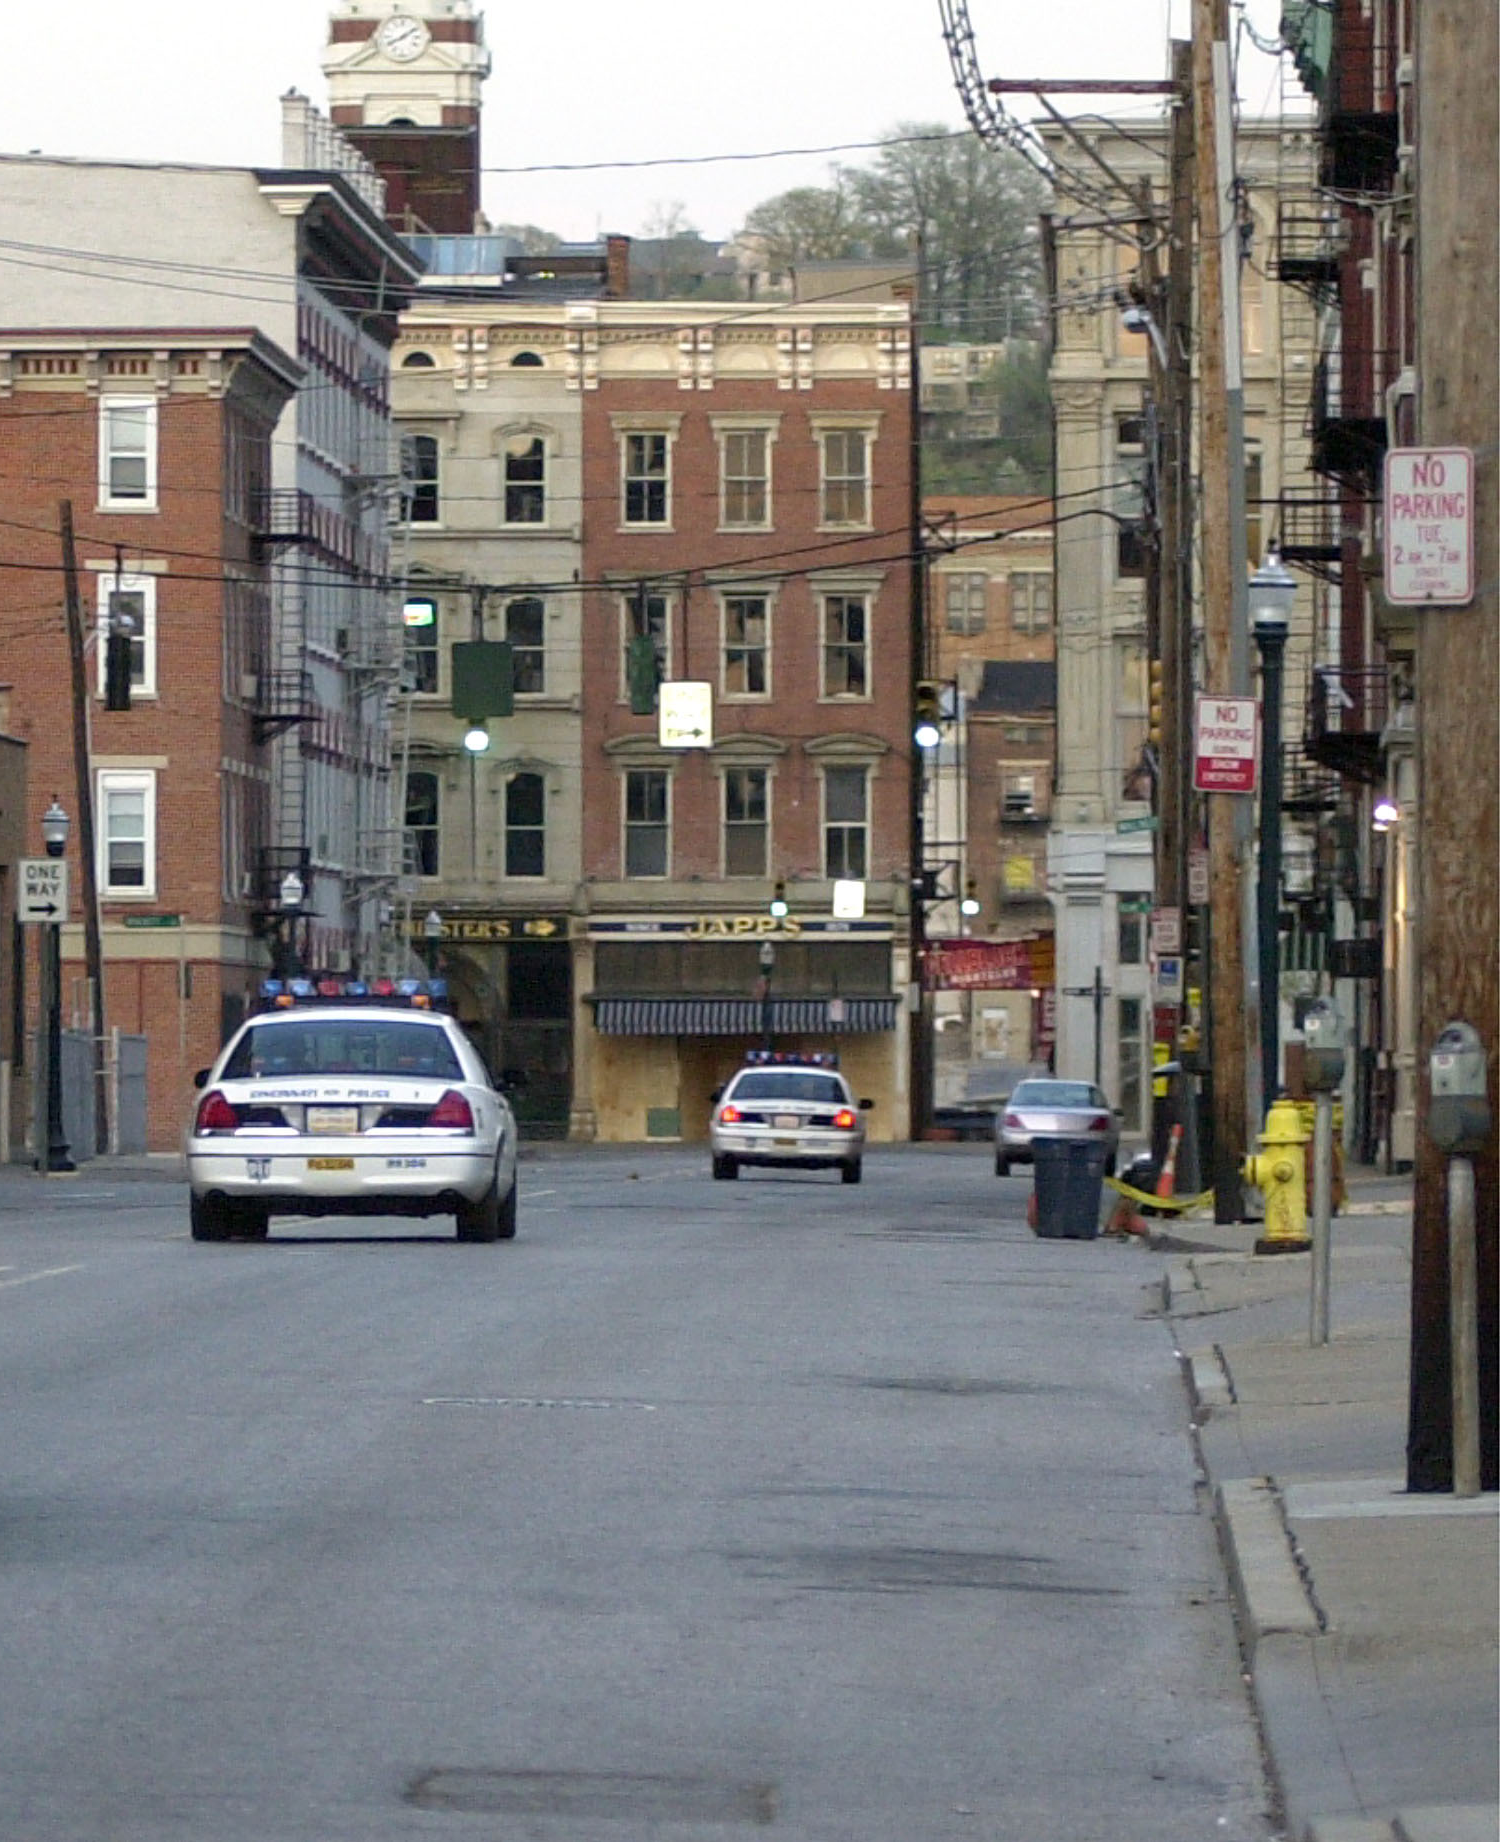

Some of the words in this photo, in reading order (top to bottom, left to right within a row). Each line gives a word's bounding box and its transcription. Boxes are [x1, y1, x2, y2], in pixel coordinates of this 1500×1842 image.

[1412, 460, 1445, 487] NO
[1392, 493, 1466, 519] PARKING
[1216, 706, 1237, 722] NO
[1200, 728, 1254, 741] PARKING
[26, 865, 60, 879] ONE
[26, 882, 60, 896] WAY
